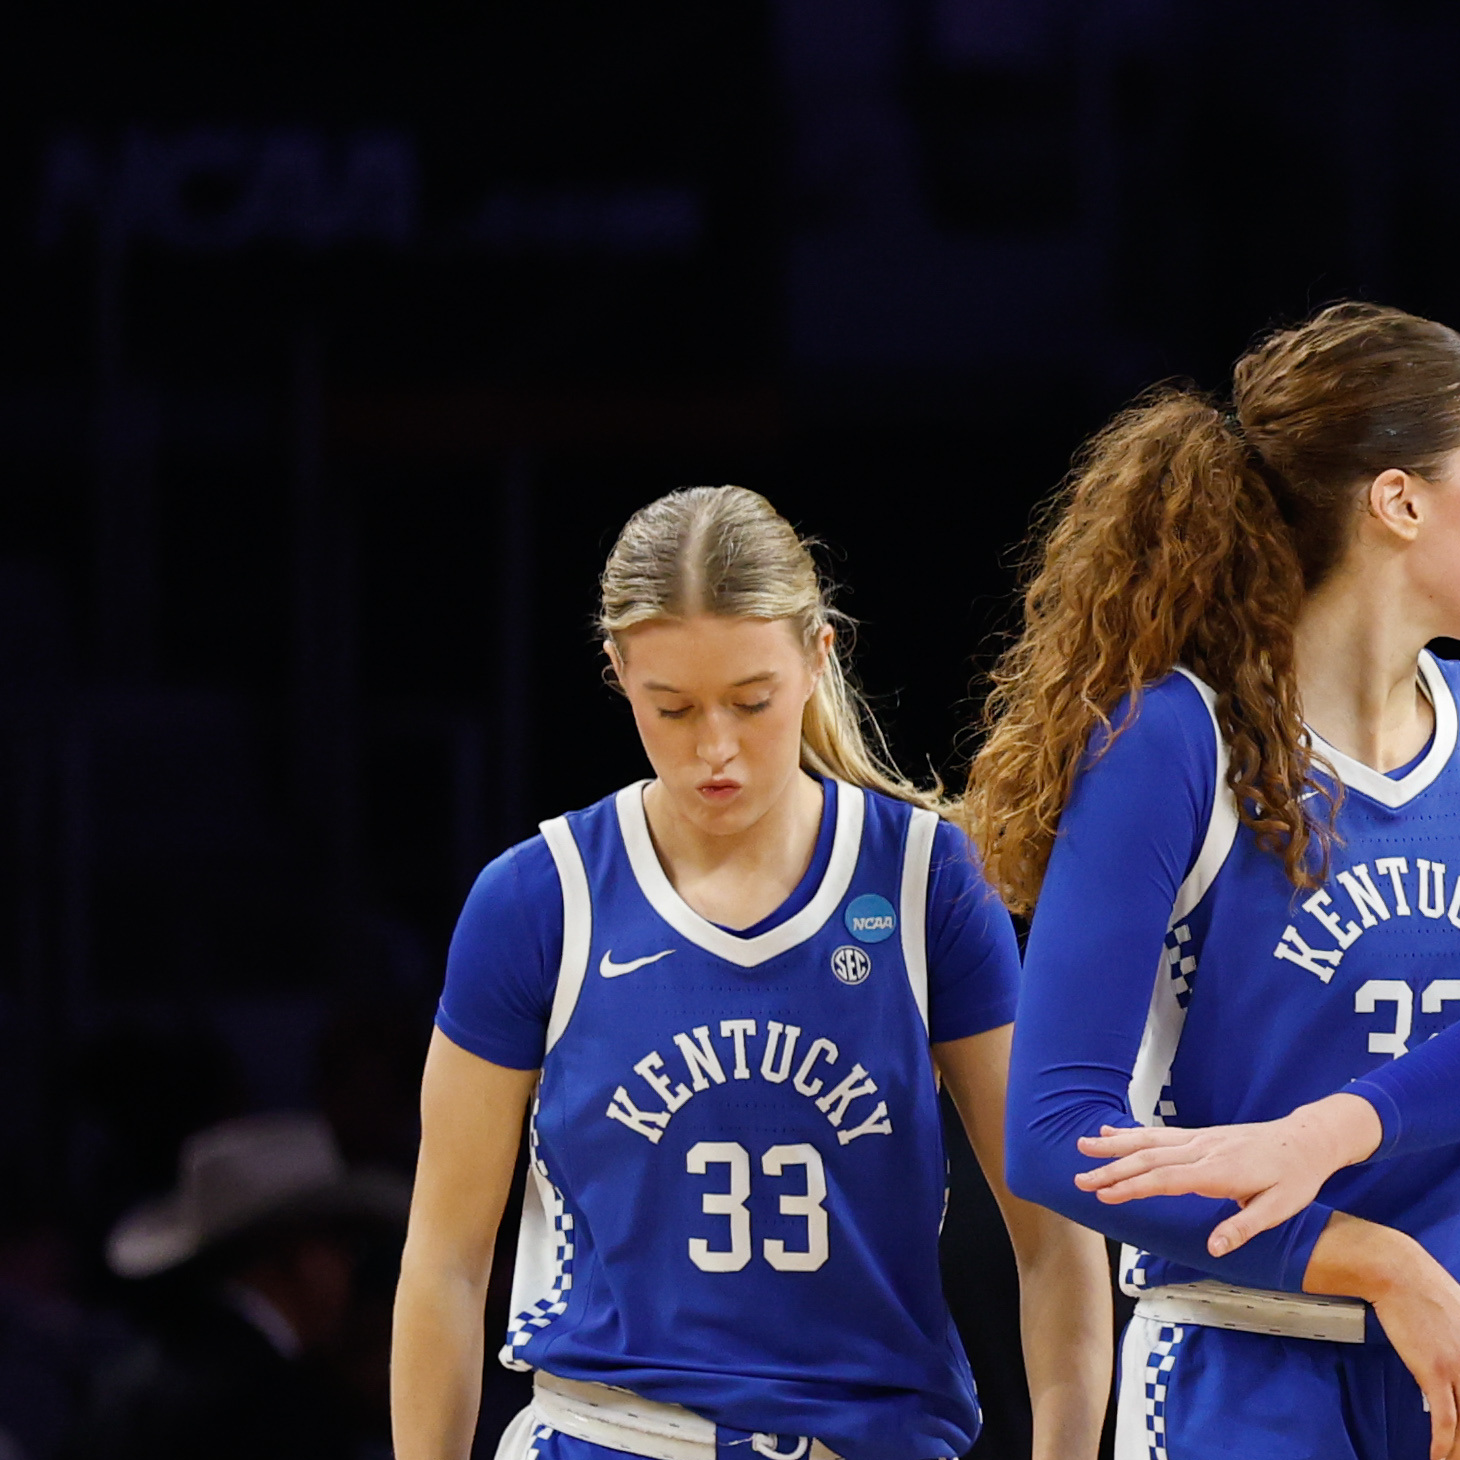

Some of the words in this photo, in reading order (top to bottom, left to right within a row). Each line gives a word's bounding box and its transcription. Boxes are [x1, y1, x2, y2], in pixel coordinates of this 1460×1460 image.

[853, 916, 894, 931] NCAA
[833, 948, 868, 982] SEC
[606, 1019, 893, 1145] KENTUCKY
[685, 1141, 829, 1273] 33
